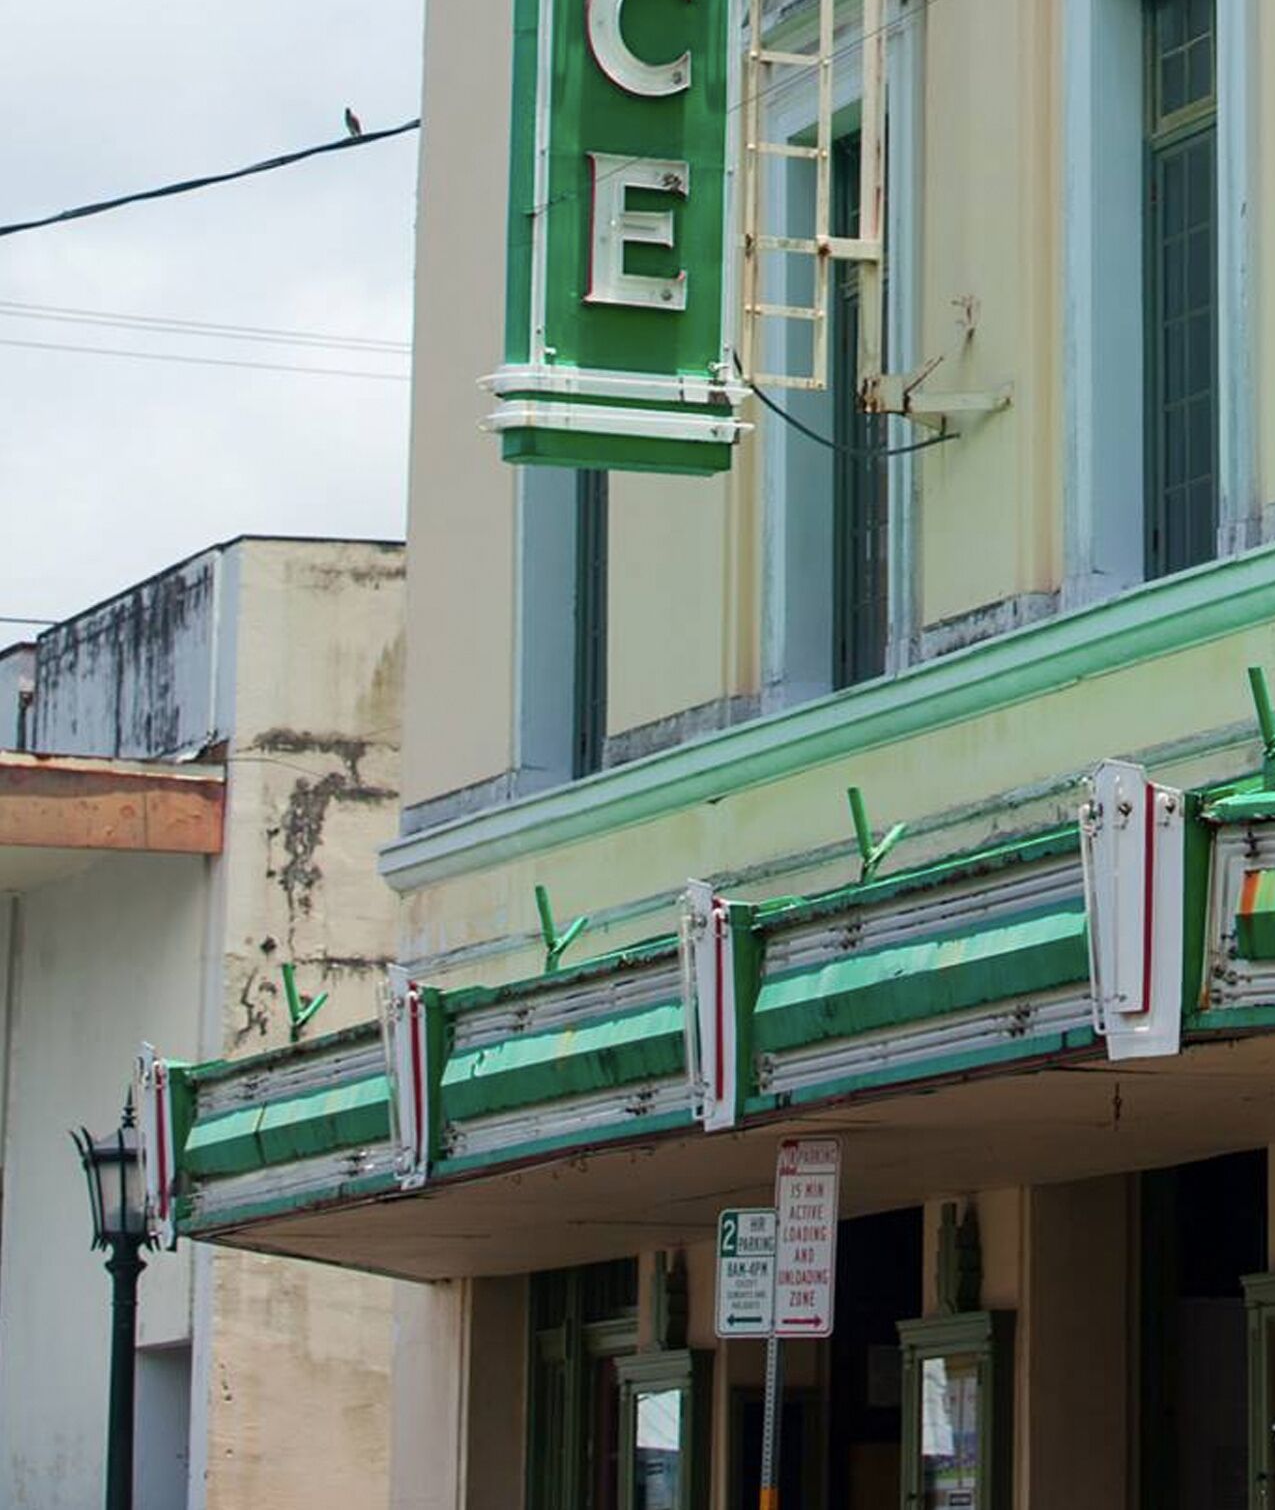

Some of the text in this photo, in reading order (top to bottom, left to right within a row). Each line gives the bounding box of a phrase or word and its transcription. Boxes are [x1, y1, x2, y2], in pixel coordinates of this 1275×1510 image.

[804, 1182, 824, 1197] MIN
[789, 1205, 824, 1220] ACTIVE
[723, 1219, 736, 1250] 2
[783, 1225, 829, 1242] LOADING
[739, 1236, 774, 1251] PARKING
[794, 1247, 815, 1263] AND
[778, 1269, 829, 1286] UNLOADING
[789, 1290, 815, 1307] ZONE
